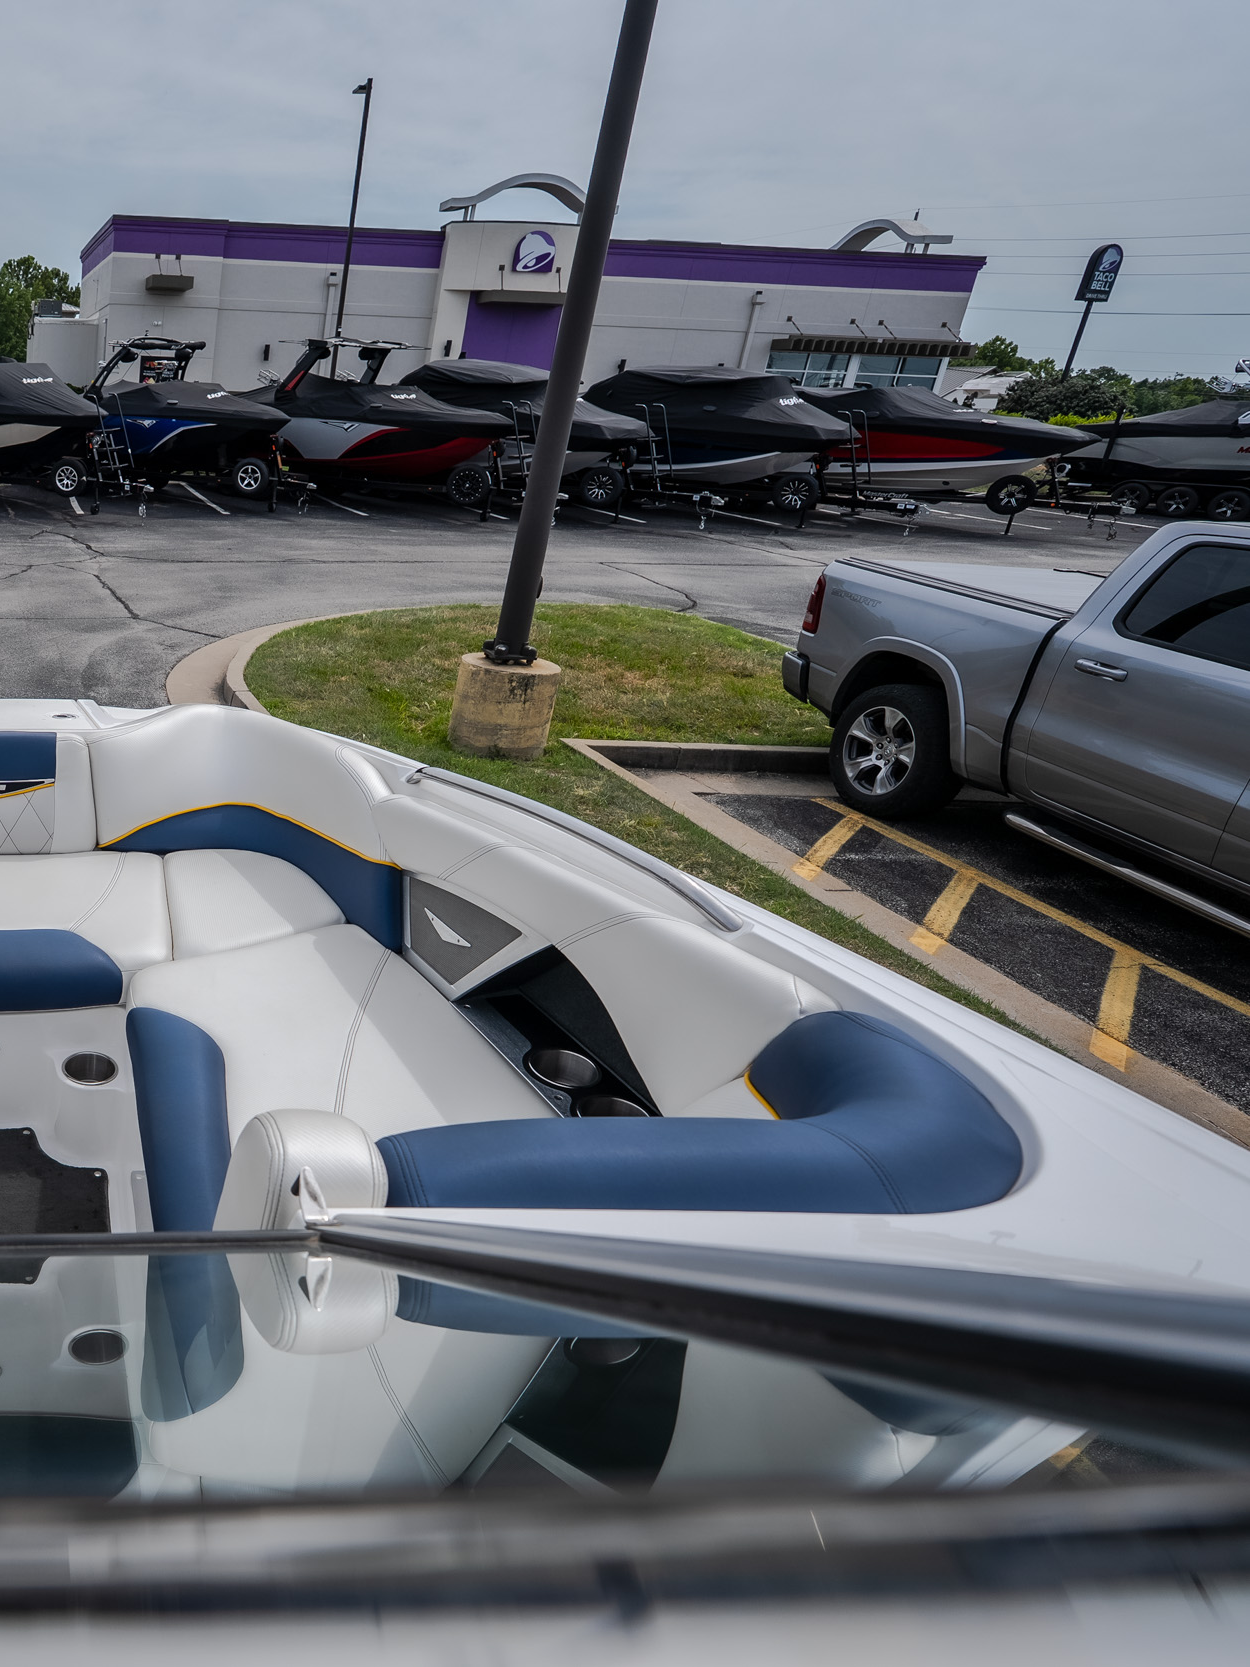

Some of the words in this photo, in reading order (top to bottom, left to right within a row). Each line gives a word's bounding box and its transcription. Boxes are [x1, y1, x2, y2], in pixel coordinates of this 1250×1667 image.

[1093, 271, 1115, 282] TACO
[1090, 280, 1110, 291] BELL
[831, 587, 883, 607] SPORT
